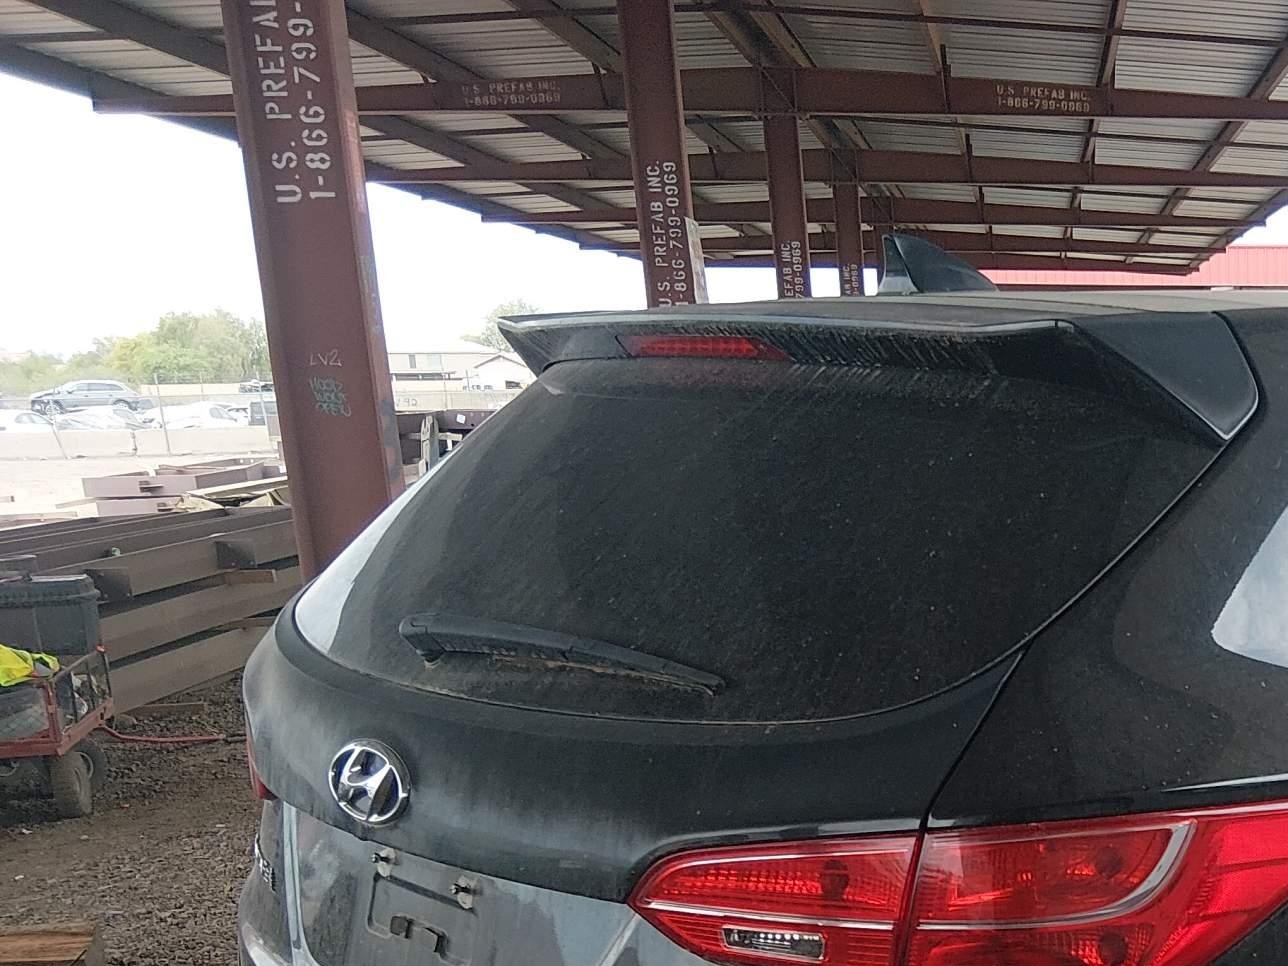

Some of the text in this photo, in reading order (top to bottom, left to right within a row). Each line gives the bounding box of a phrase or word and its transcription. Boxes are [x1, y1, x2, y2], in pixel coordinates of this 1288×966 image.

[249, 0, 302, 203] U.S. PREFA
[1023, 86, 1065, 99] PREFAB
[646, 160, 672, 307] U.S. PREFAB INC.
[662, 161, 689, 306] 1-866-799-0969
[781, 240, 791, 262] INC.
